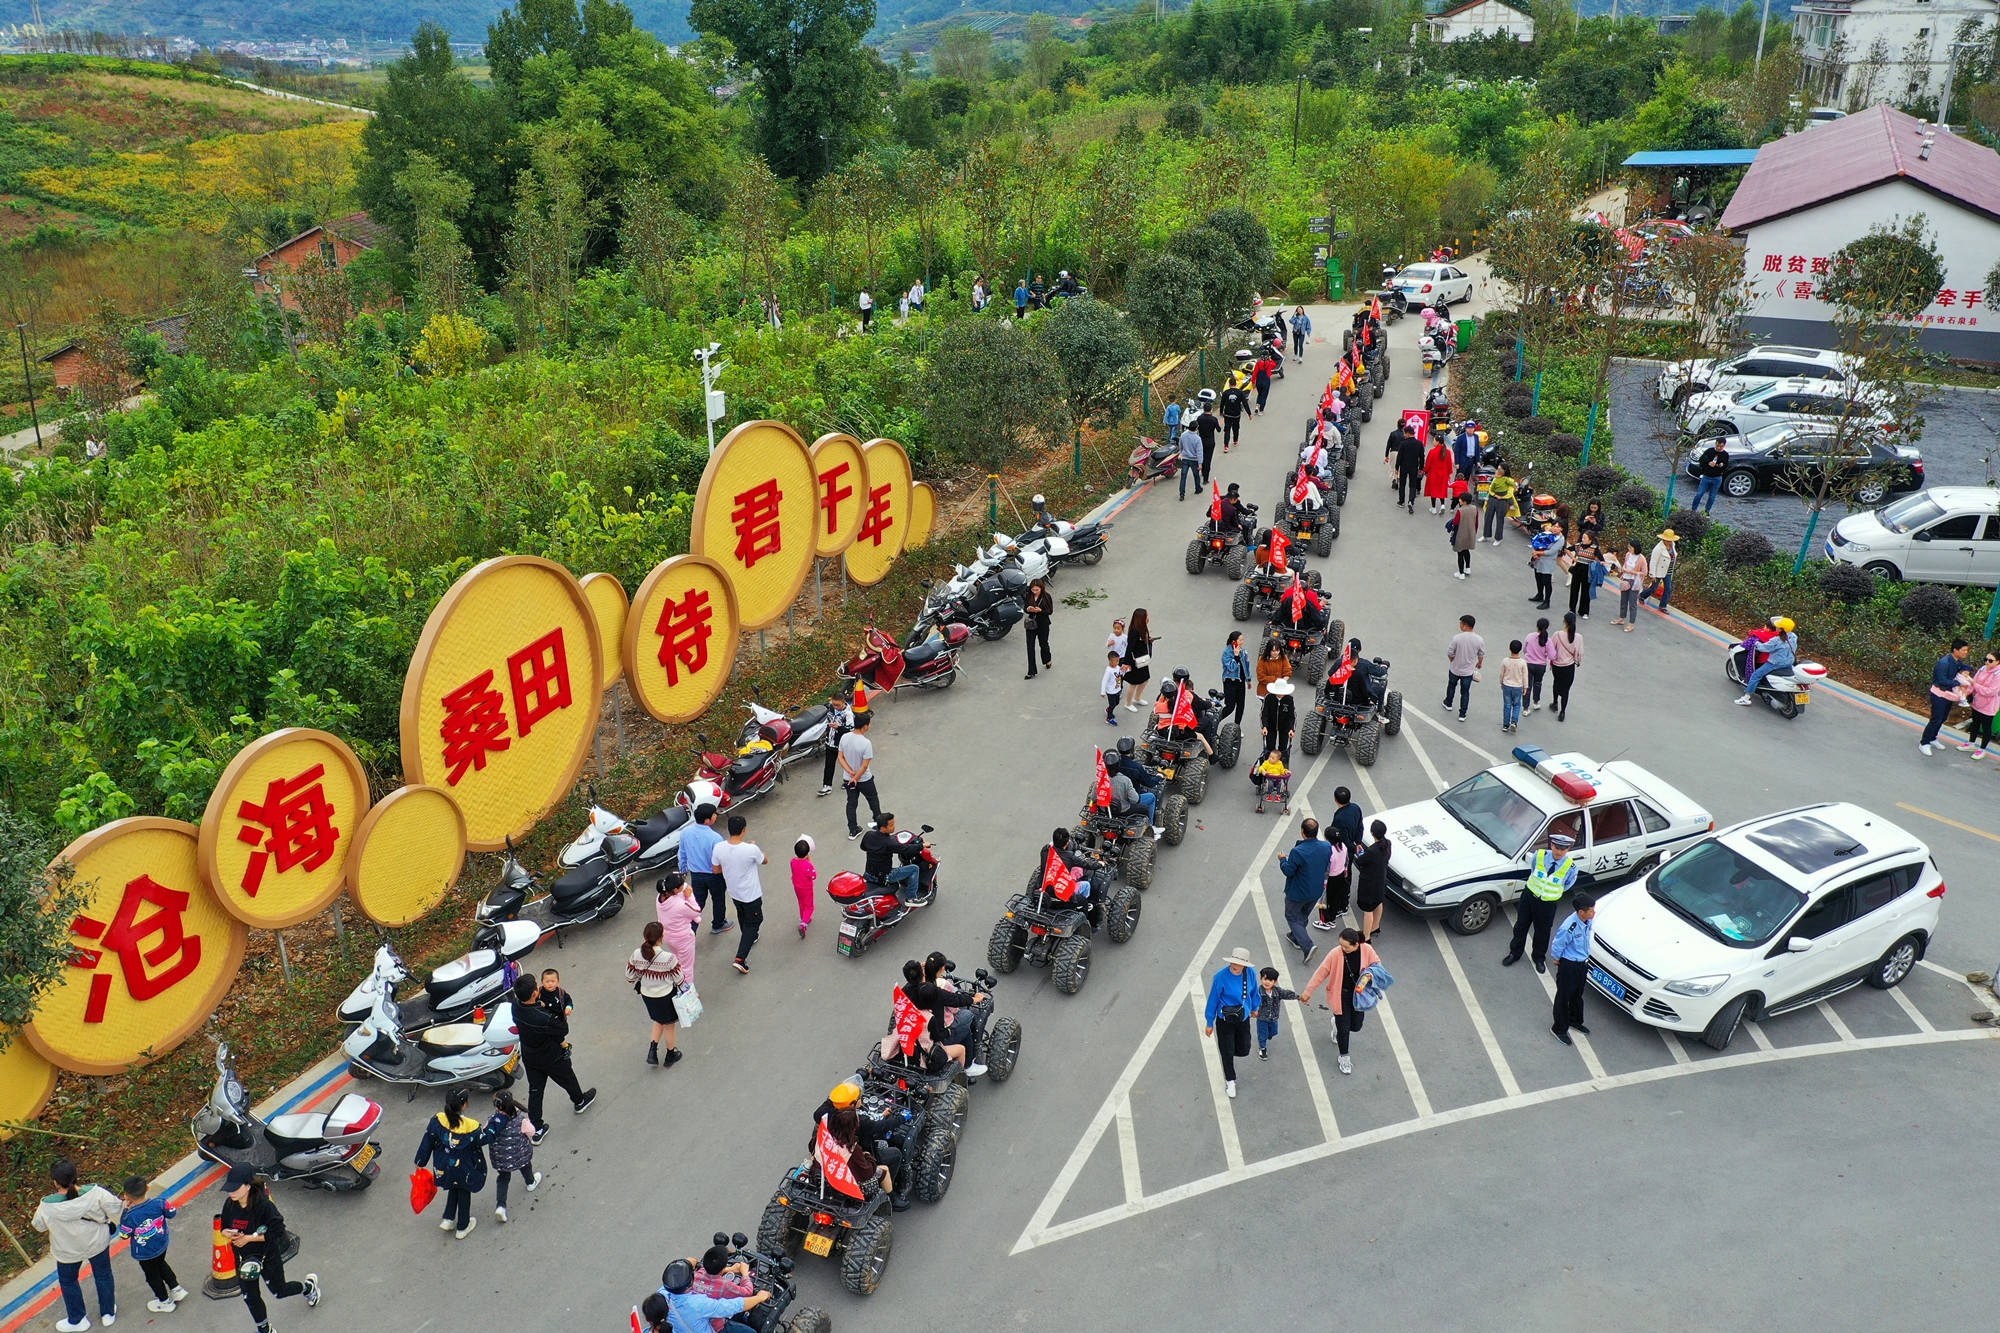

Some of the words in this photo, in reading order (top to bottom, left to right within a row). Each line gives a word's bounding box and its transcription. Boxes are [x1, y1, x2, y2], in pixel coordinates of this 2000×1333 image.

[1762, 254, 1856, 276] 脱贫致
[731, 478, 783, 568] 君
[857, 483, 893, 546] 年
[654, 588, 712, 688] 待
[440, 626, 572, 787] 桑田
[237, 763, 340, 898] 海
[1391, 830, 1429, 859] POLICE
[1595, 851, 1629, 872] 公安
[67, 873, 202, 1023] 沧
